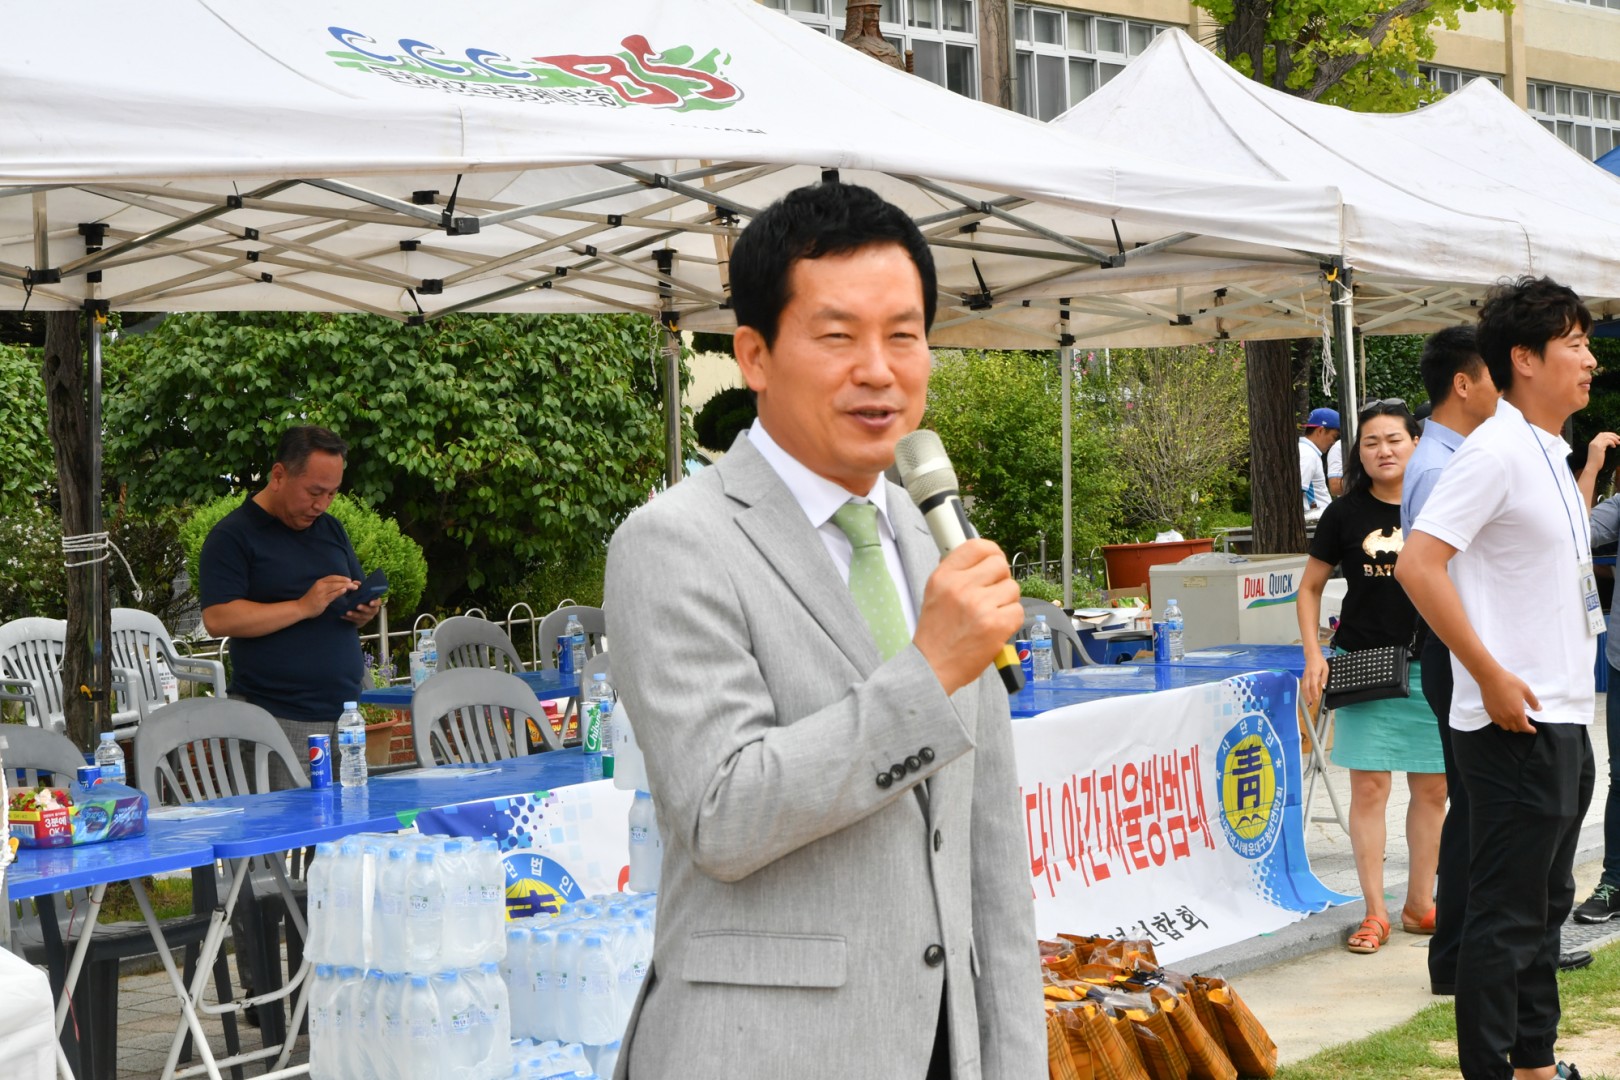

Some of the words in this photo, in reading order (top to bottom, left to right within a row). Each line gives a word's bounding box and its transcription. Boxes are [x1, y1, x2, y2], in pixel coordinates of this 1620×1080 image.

[1243, 577, 1265, 599] DUAL
[1268, 572, 1293, 596] QUICK
[1221, 718, 1275, 755] 사단법인
[1019, 782, 1061, 900] 다!
[1061, 744, 1216, 888] 야간자율방범대
